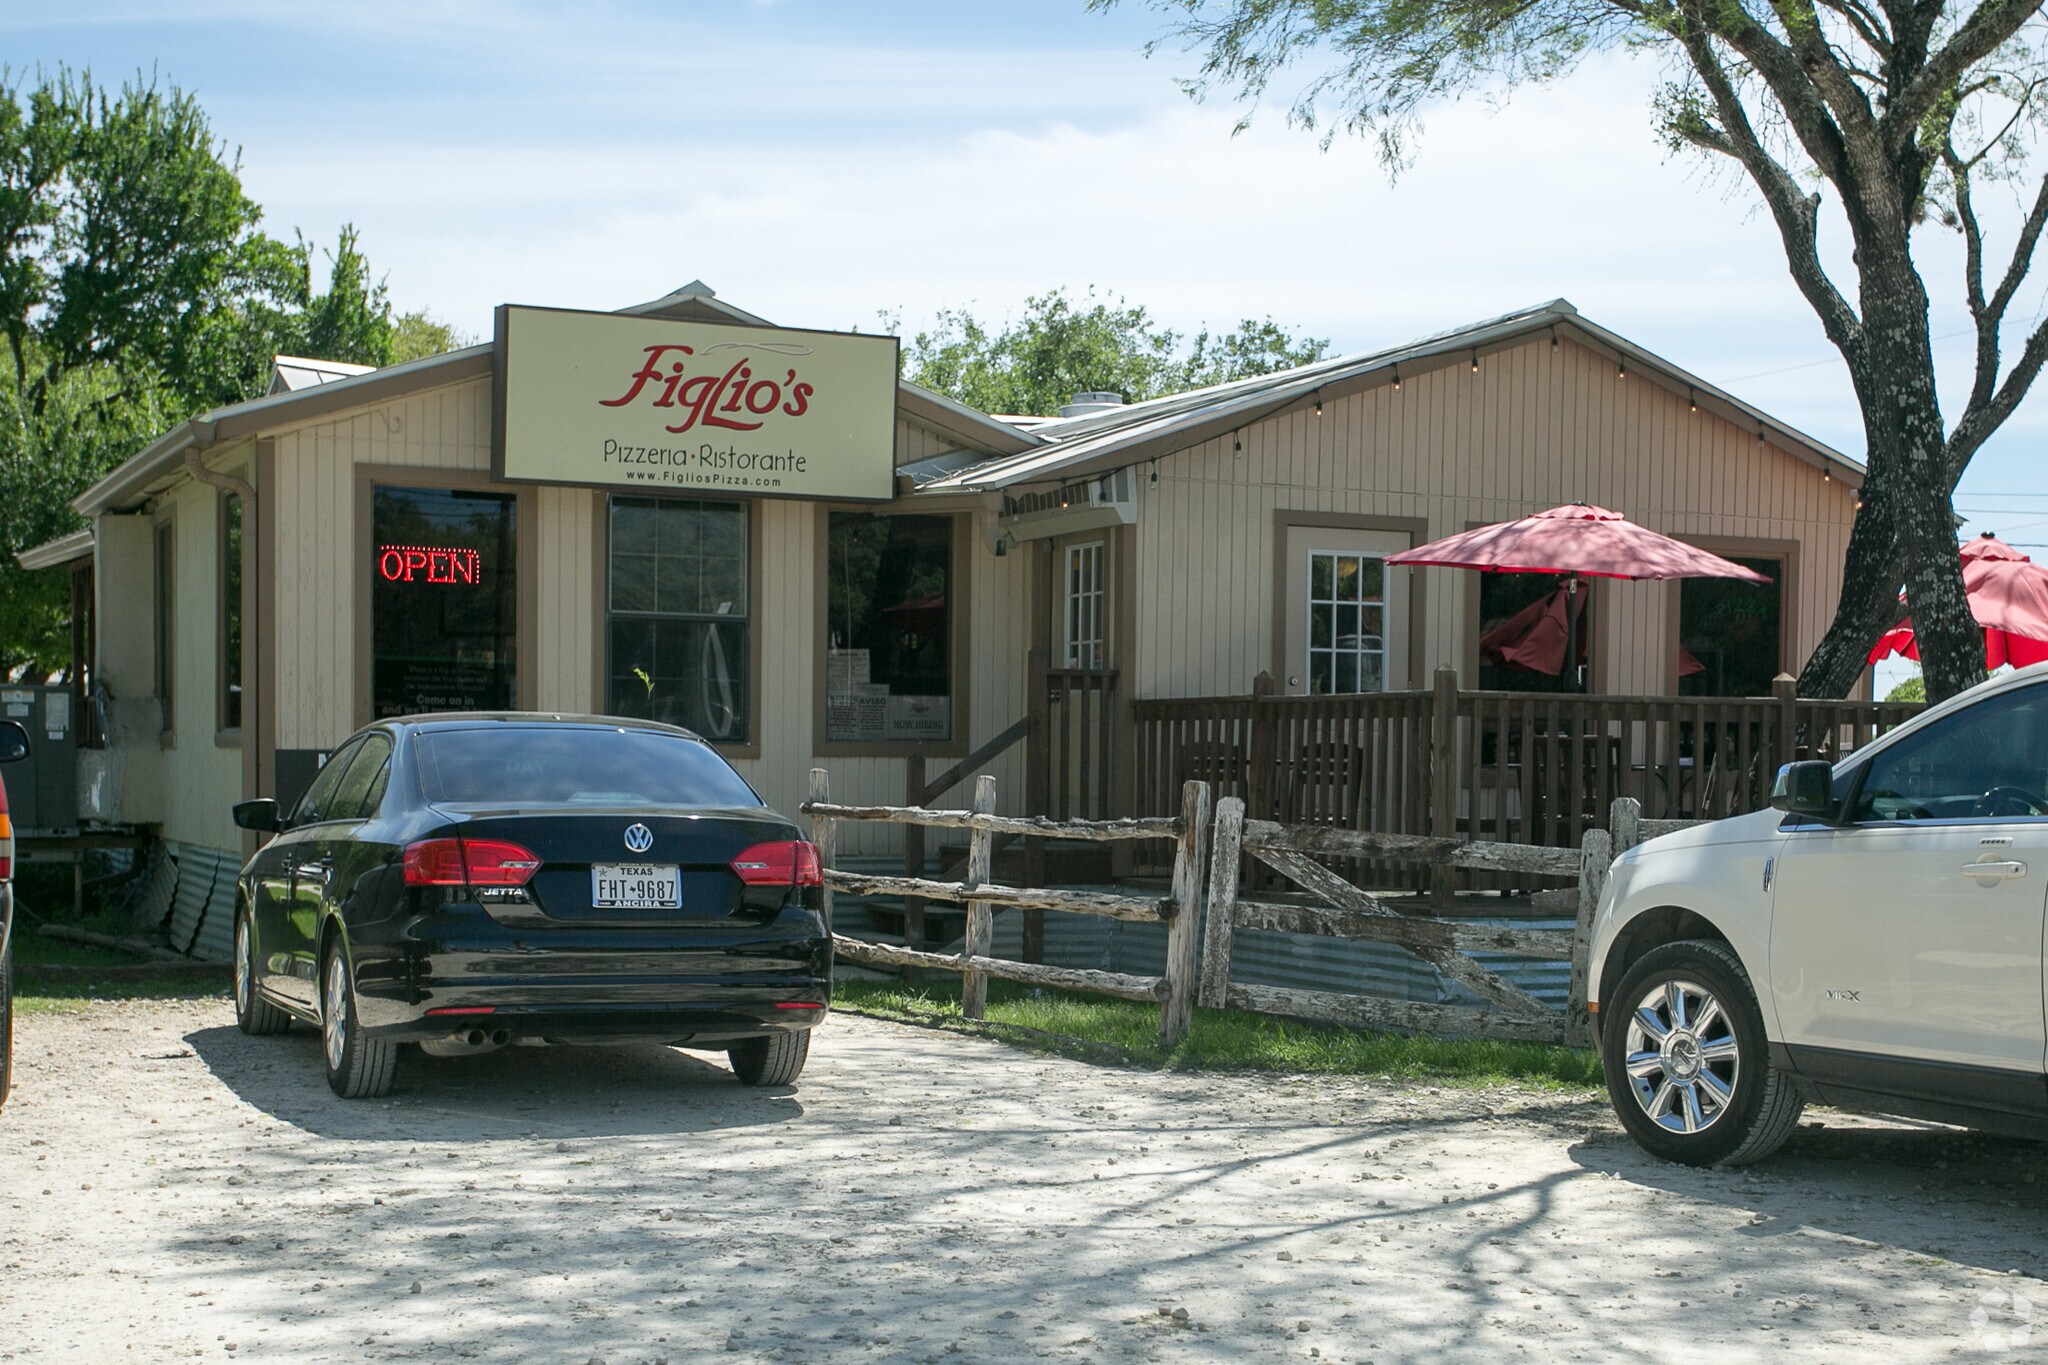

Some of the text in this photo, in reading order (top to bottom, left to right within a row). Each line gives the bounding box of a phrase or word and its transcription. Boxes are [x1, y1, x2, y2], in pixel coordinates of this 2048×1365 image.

[603, 438, 807, 473] Pizzeria Ristorante
[626, 470, 781, 487] www.FigliosPizza.com
[379, 550, 475, 584] OPEN
[416, 694, 474, 706] Come on in
[860, 697, 887, 705] AVISO
[382, 705, 401, 715] and
[893, 719, 914, 729] NOW
[620, 867, 653, 876] TEXAS
[483, 888, 523, 896] JETTA
[1826, 989, 1861, 1002] MKX
